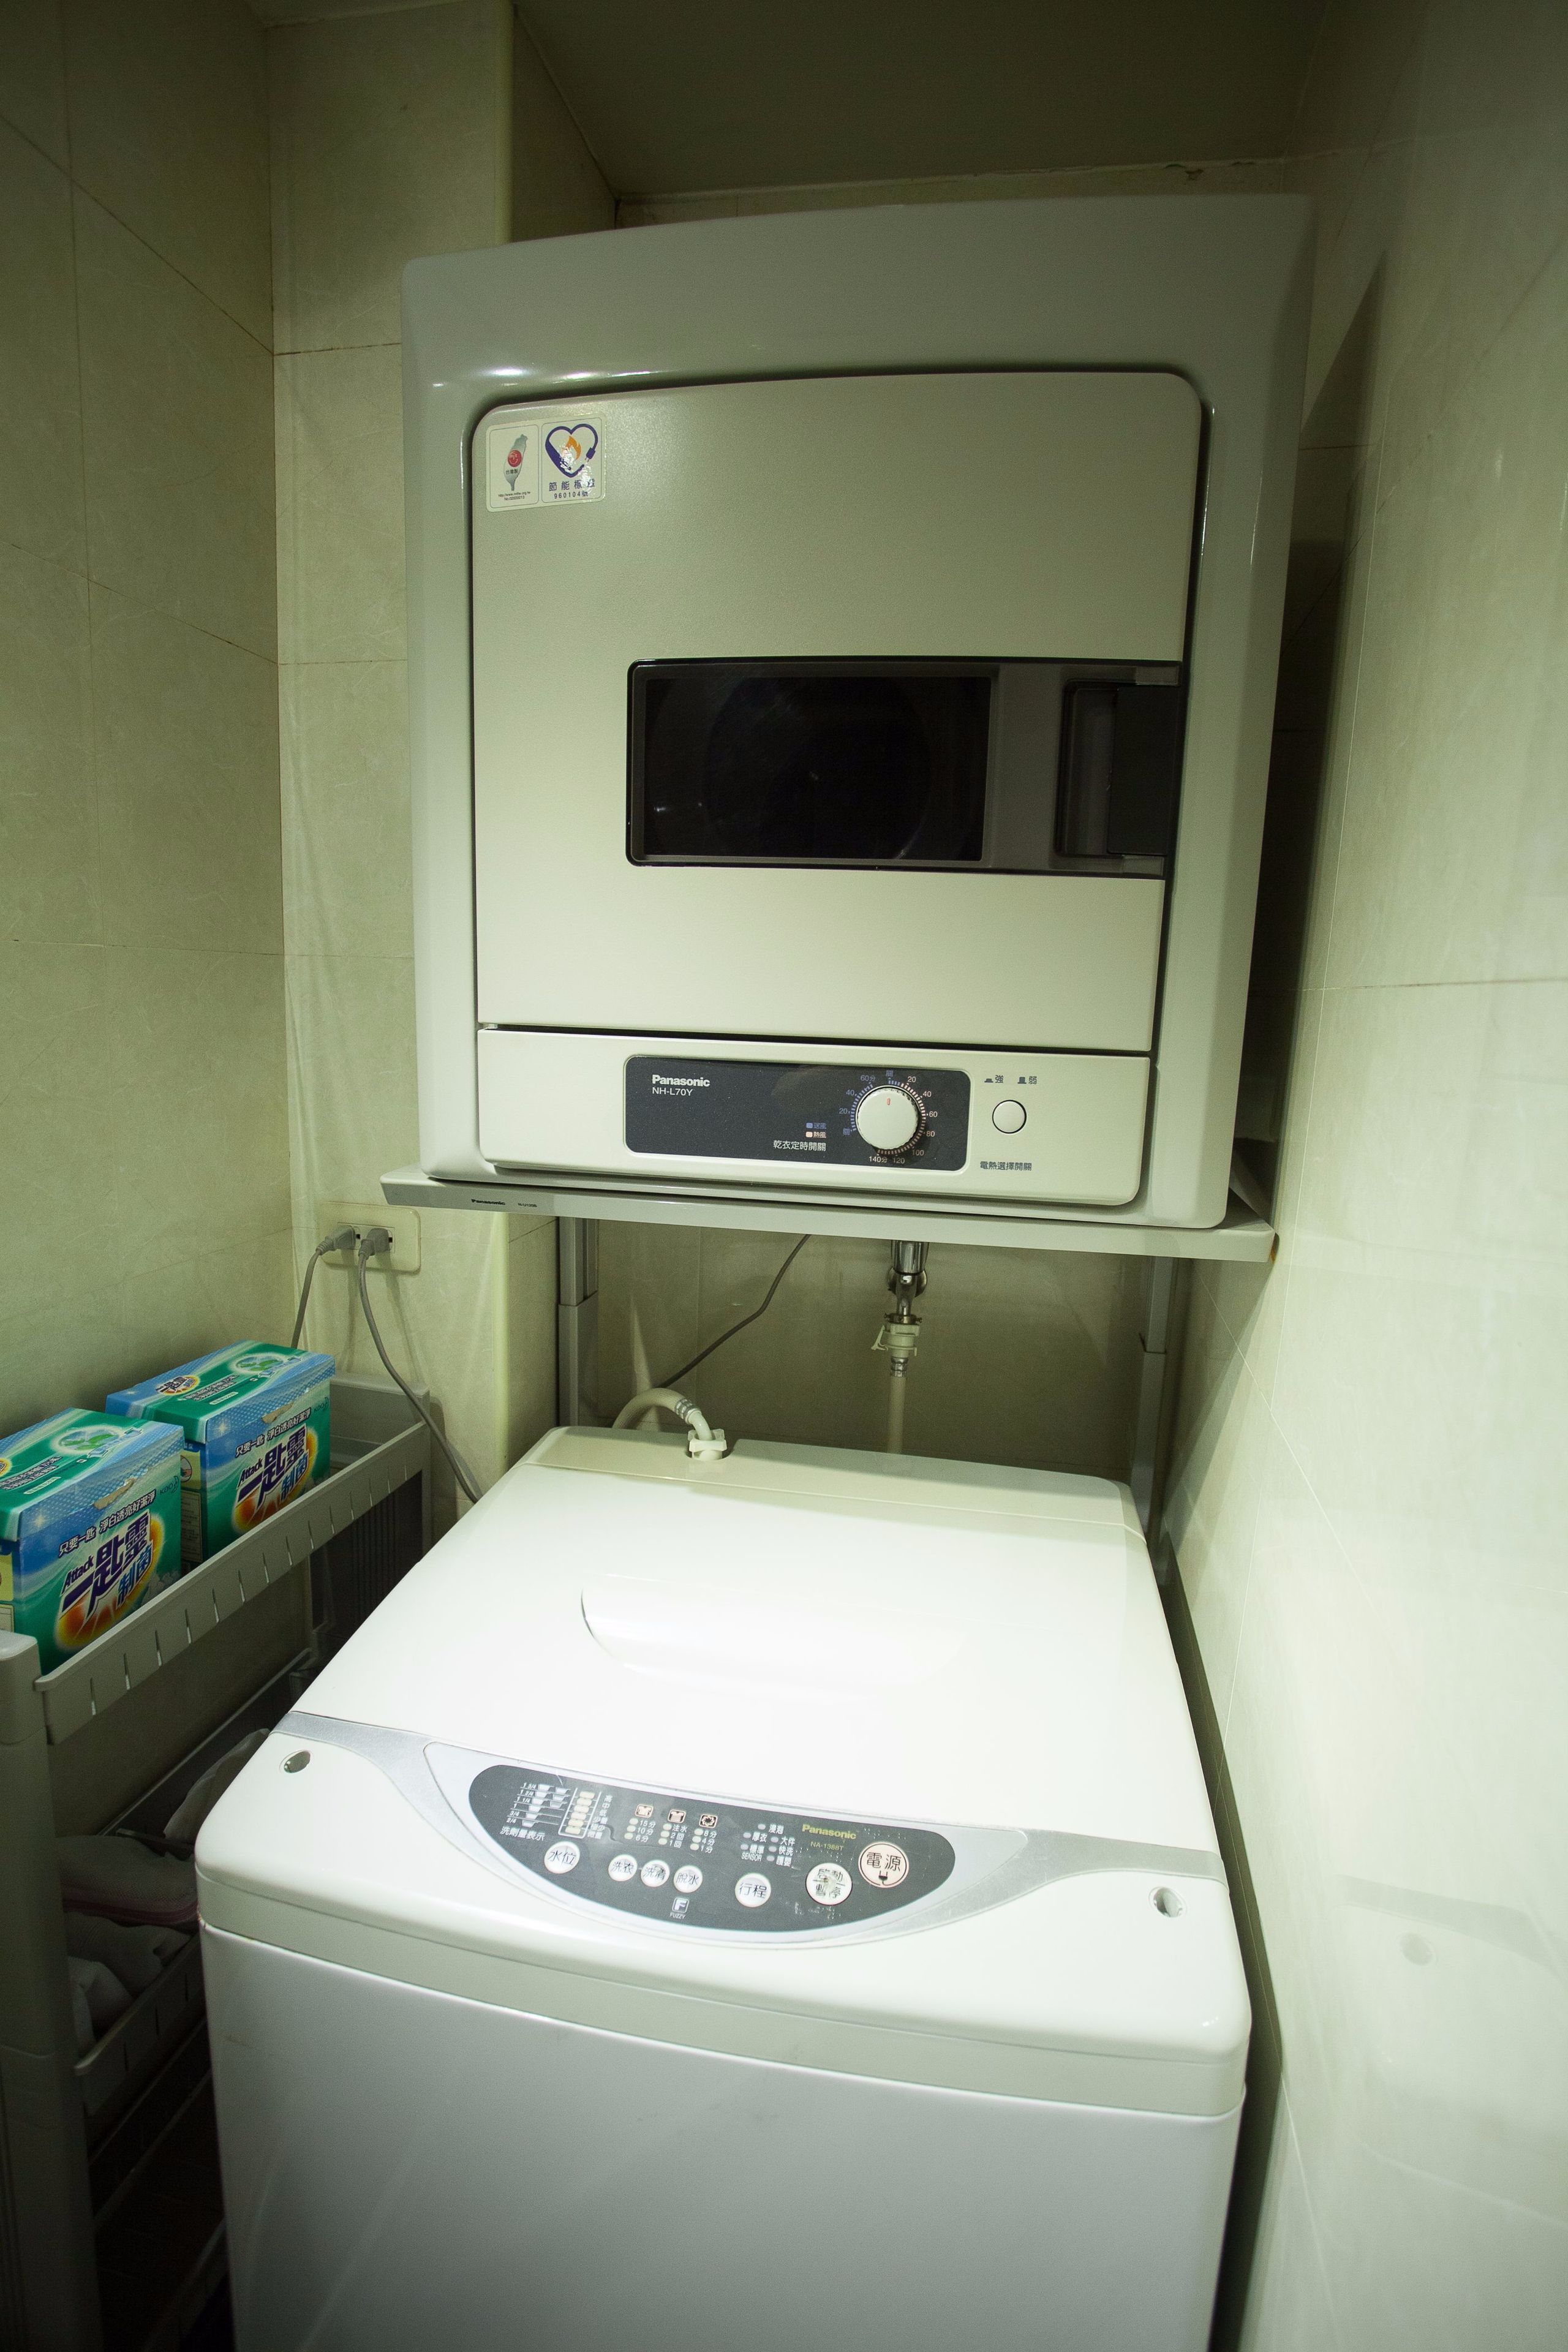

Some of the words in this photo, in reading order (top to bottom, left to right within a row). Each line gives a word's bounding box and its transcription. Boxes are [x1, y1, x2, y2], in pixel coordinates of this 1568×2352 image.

[652, 1074, 710, 1087] Panasonic
[995, 1075, 1004, 1084] 強
[1028, 1076, 1037, 1085] 弱
[652, 1087, 693, 1096] NH-L70Y
[773, 1140, 826, 1152] 乾衣定時開關
[980, 1161, 1032, 1171] 電熱選擇開關
[235, 1434, 265, 1458] 只要一匙
[238, 1458, 263, 1488] Attack
[59, 1526, 97, 1558] 只要一匙
[62, 1556, 94, 1595] Attack
[500, 1826, 546, 1841] 洗劑量表示
[802, 1824, 857, 1839] Panasonic
[780, 1836, 796, 1847] 大件
[741, 1852, 762, 1862] SENSOR
[778, 1845, 794, 1856] 快洗
[548, 1850, 577, 1866] 水位
[867, 1852, 902, 1872] 電源
[611, 1861, 635, 1874] 洗衣
[643, 1866, 666, 1880] 洗清
[676, 1872, 699, 1885] 脫水
[739, 1882, 767, 1899] 行程
